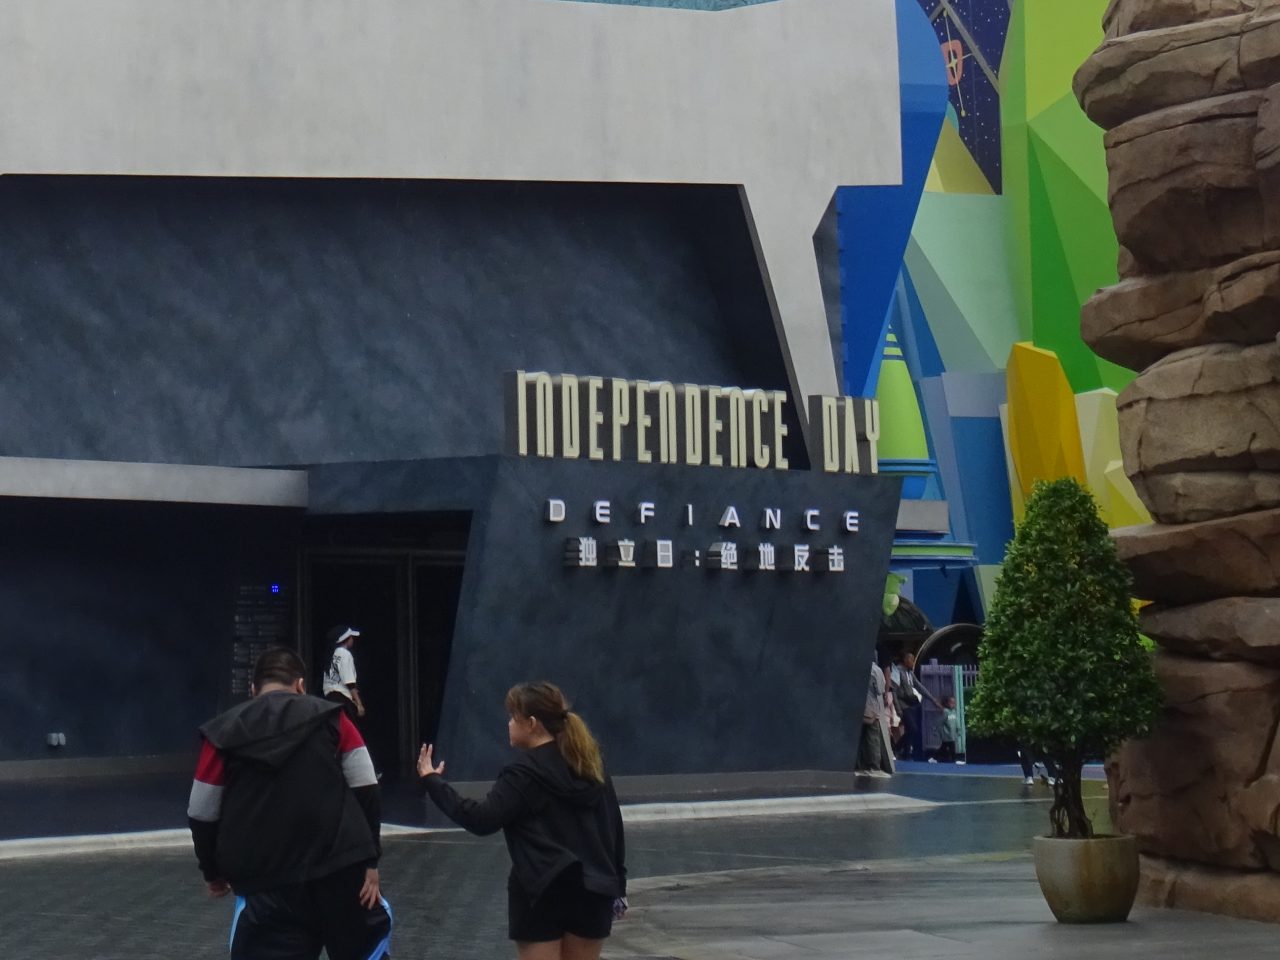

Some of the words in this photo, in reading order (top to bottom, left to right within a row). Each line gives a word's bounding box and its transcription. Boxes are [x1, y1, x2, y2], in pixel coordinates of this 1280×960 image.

[516, 370, 789, 470] INDEPENDENCE
[821, 395, 880, 474] DAY
[547, 498, 859, 532] DEFIANCE
